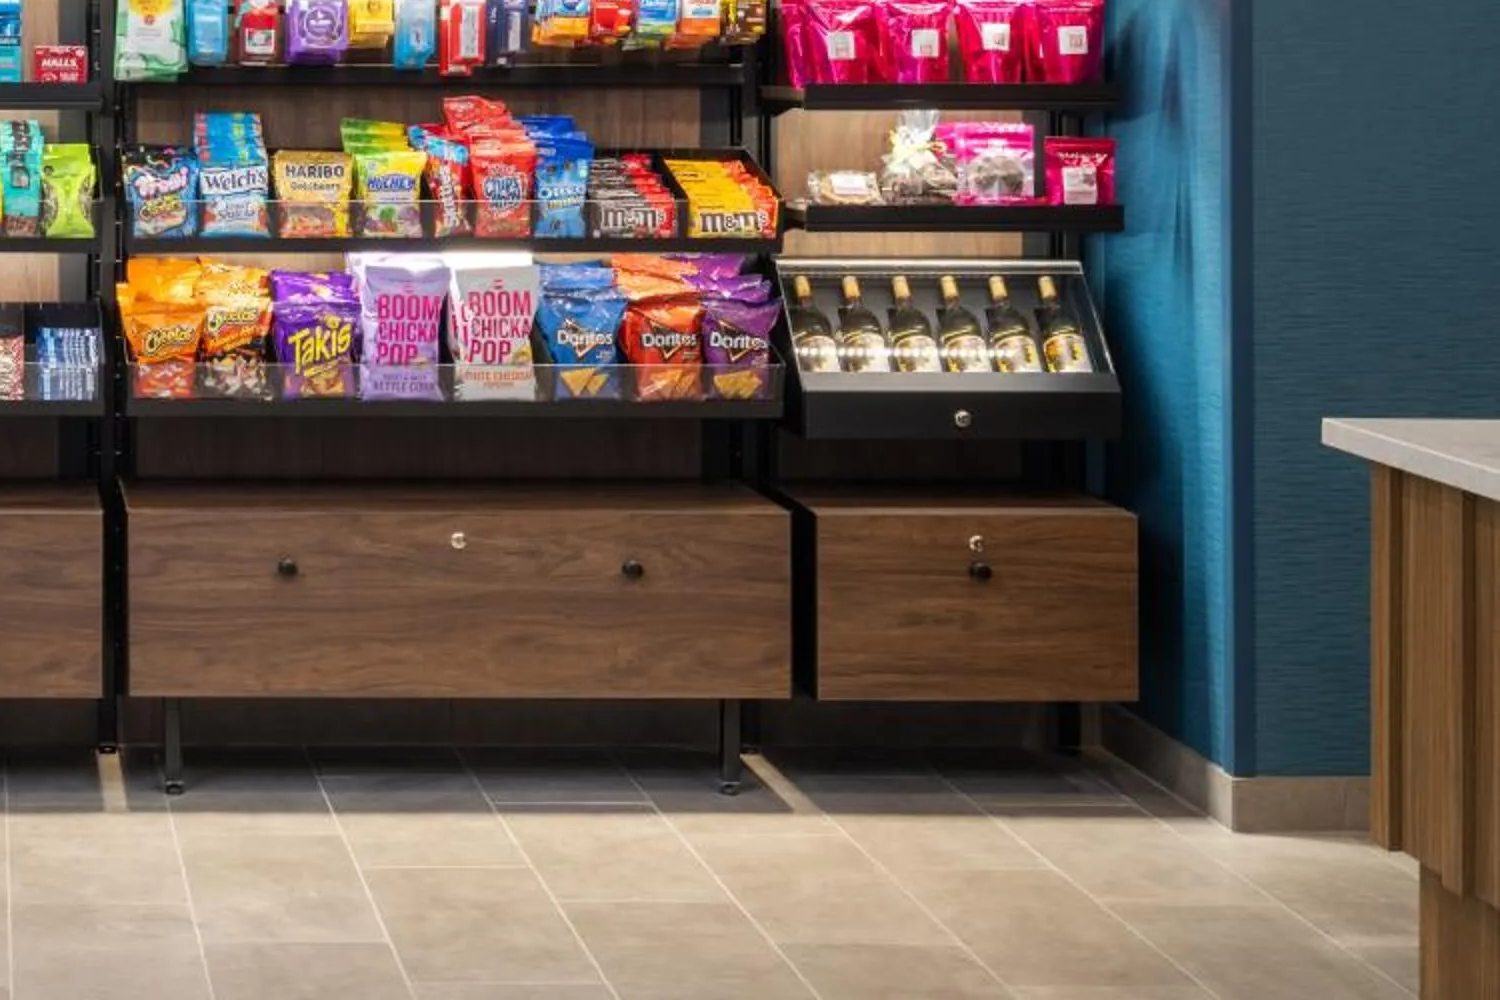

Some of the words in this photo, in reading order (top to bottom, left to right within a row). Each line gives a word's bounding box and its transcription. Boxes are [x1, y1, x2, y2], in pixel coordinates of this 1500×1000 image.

[204, 168, 267, 191] Welch's
[285, 164, 345, 179] HARIBO
[377, 293, 442, 321] BOOM
[468, 290, 532, 316] BOOM
[378, 322, 437, 342] CHICKA
[470, 316, 531, 338] CHICKA
[557, 329, 613, 346] Doritos
[288, 316, 353, 376] Takis
[469, 338, 512, 364] POP
[641, 332, 698, 348] Doritos
[709, 331, 769, 350] Doritos
[376, 342, 419, 365] POP
